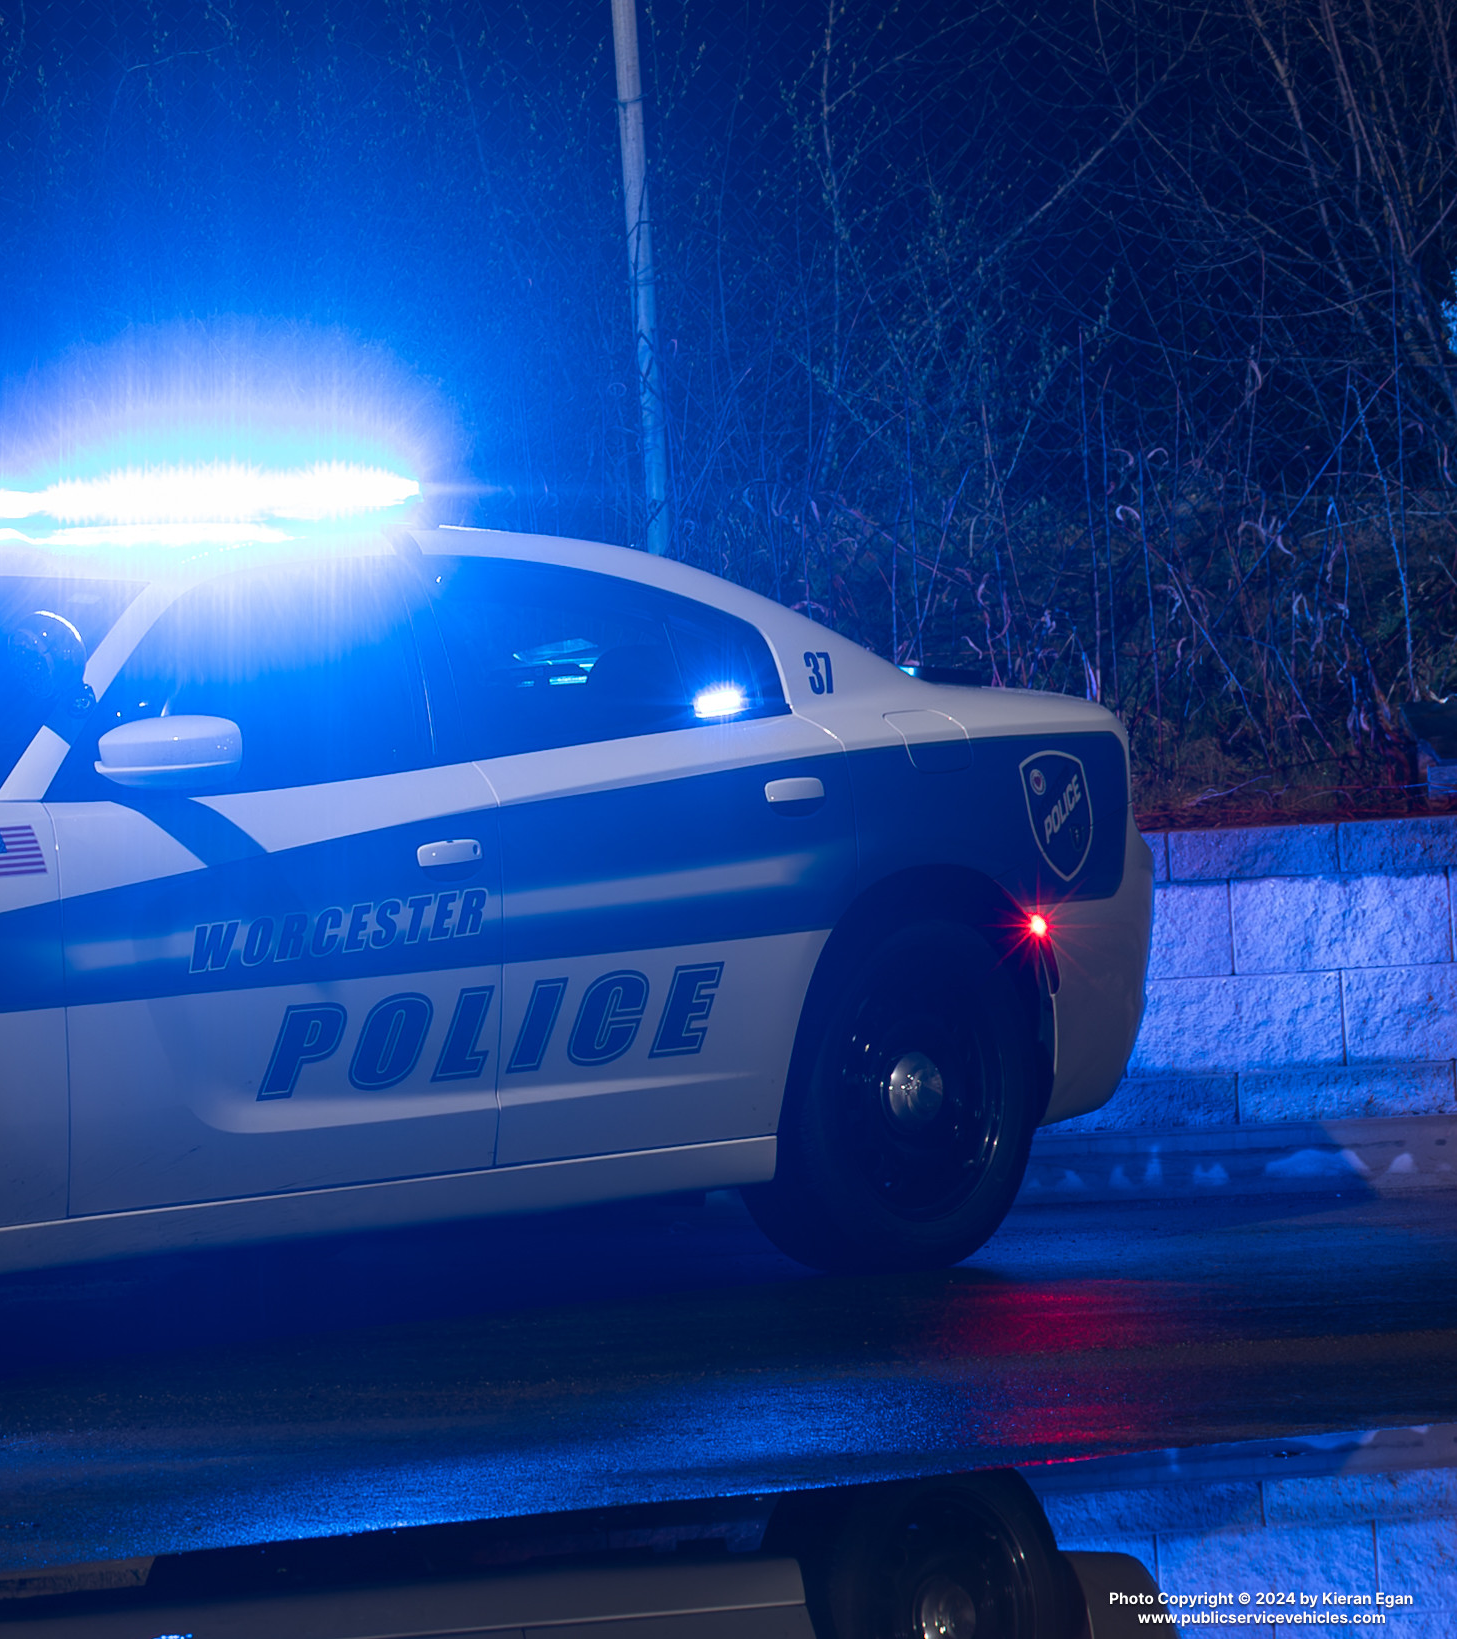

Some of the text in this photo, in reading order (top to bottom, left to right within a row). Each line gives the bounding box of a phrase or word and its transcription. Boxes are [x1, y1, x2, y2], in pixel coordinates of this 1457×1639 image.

[804, 651, 834, 695] 37
[1044, 774, 1082, 844] POLICE
[188, 886, 489, 973] WORCESTER
[256, 960, 725, 1101] POLICE
